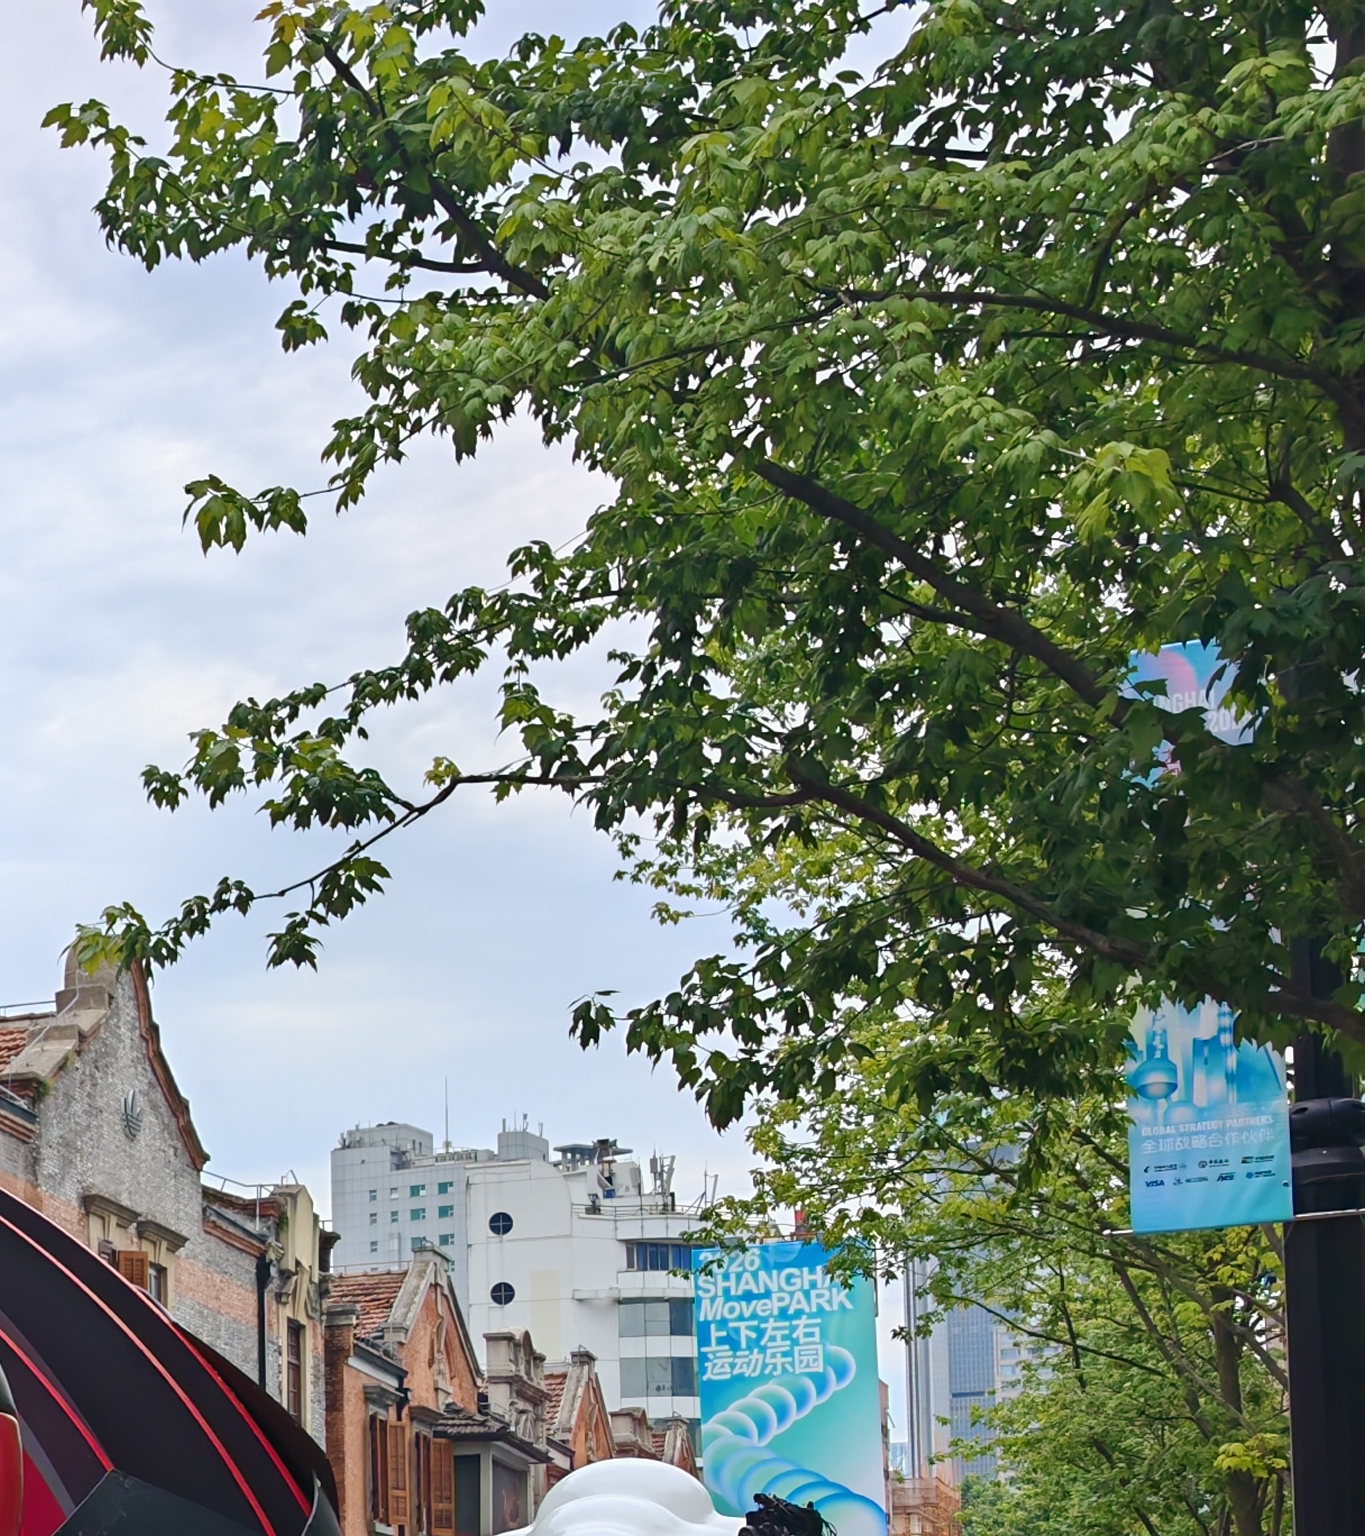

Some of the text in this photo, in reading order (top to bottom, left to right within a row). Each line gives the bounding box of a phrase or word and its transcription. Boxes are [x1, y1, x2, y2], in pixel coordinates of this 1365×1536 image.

[1141, 1128, 1274, 1154] 全球战略合作伙伴
[1179, 1120, 1224, 1133] STRATEGY
[1226, 1115, 1274, 1127] PARTNERS
[697, 1264, 852, 1298] SHANGH
[699, 1288, 854, 1322] MovePARK
[700, 1315, 822, 1353] 上下左右
[701, 1344, 824, 1381] 运动乐园
